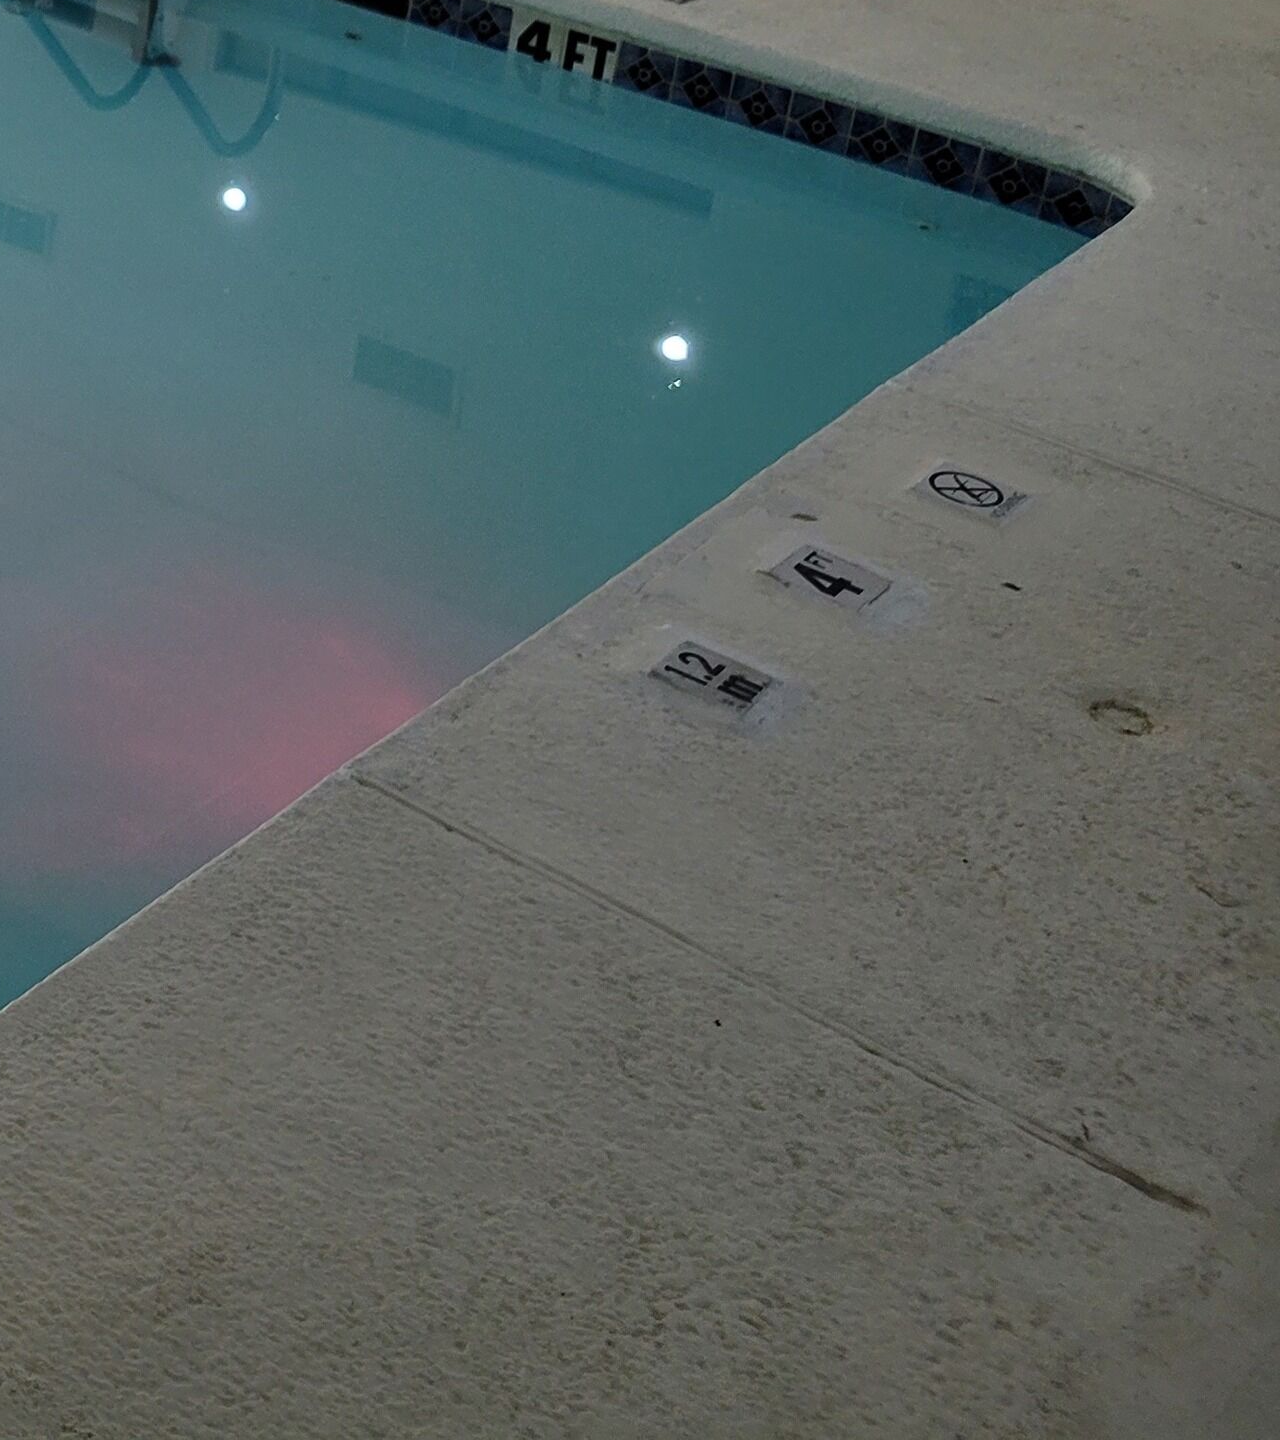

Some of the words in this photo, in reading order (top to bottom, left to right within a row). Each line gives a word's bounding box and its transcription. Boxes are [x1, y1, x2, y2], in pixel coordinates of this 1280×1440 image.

[517, 20, 552, 63] 4
[562, 29, 617, 81] FT
[793, 562, 864, 597] 4
[664, 652, 727, 686] 1.2
